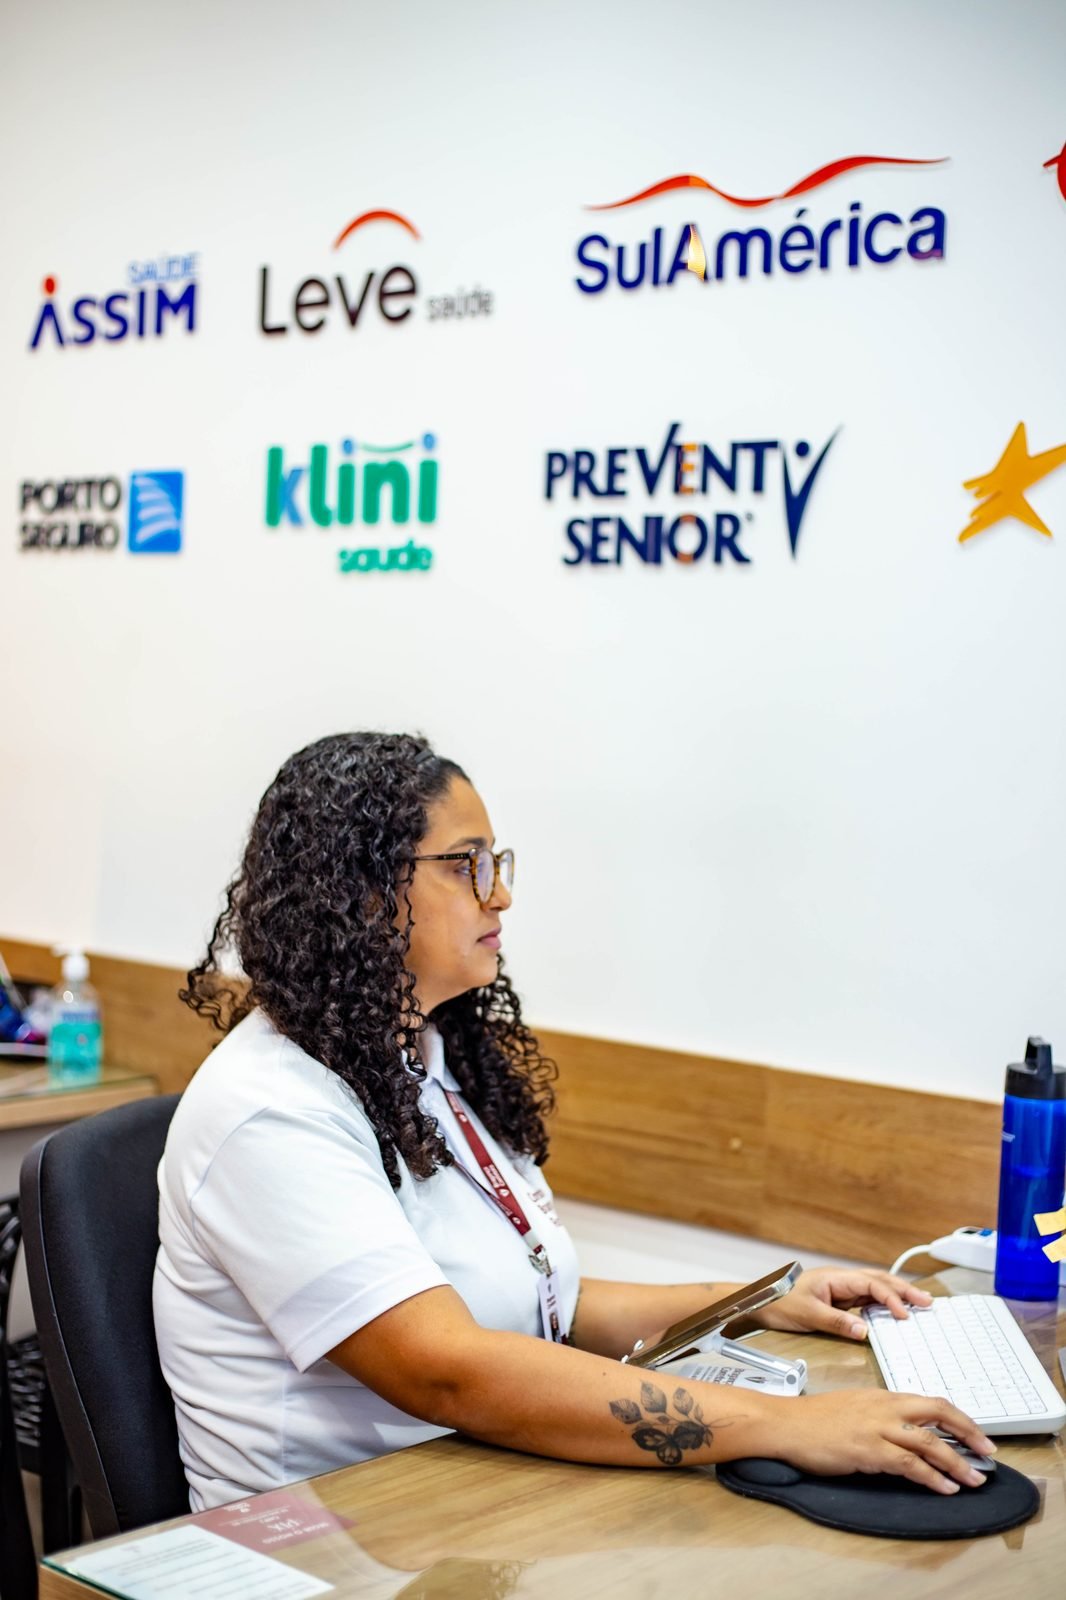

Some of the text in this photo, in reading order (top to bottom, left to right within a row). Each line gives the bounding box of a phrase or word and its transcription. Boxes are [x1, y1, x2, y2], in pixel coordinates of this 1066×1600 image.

[574, 201, 947, 296] SulAmérica
[29, 275, 198, 351] ASSIM
[258, 265, 418, 338] Leve
[19, 476, 122, 514] PORTO
[264, 432, 439, 528] klini
[544, 422, 780, 502] PREVENT
[19, 519, 120, 553] SEGURO
[562, 512, 752, 567] SENIOR
